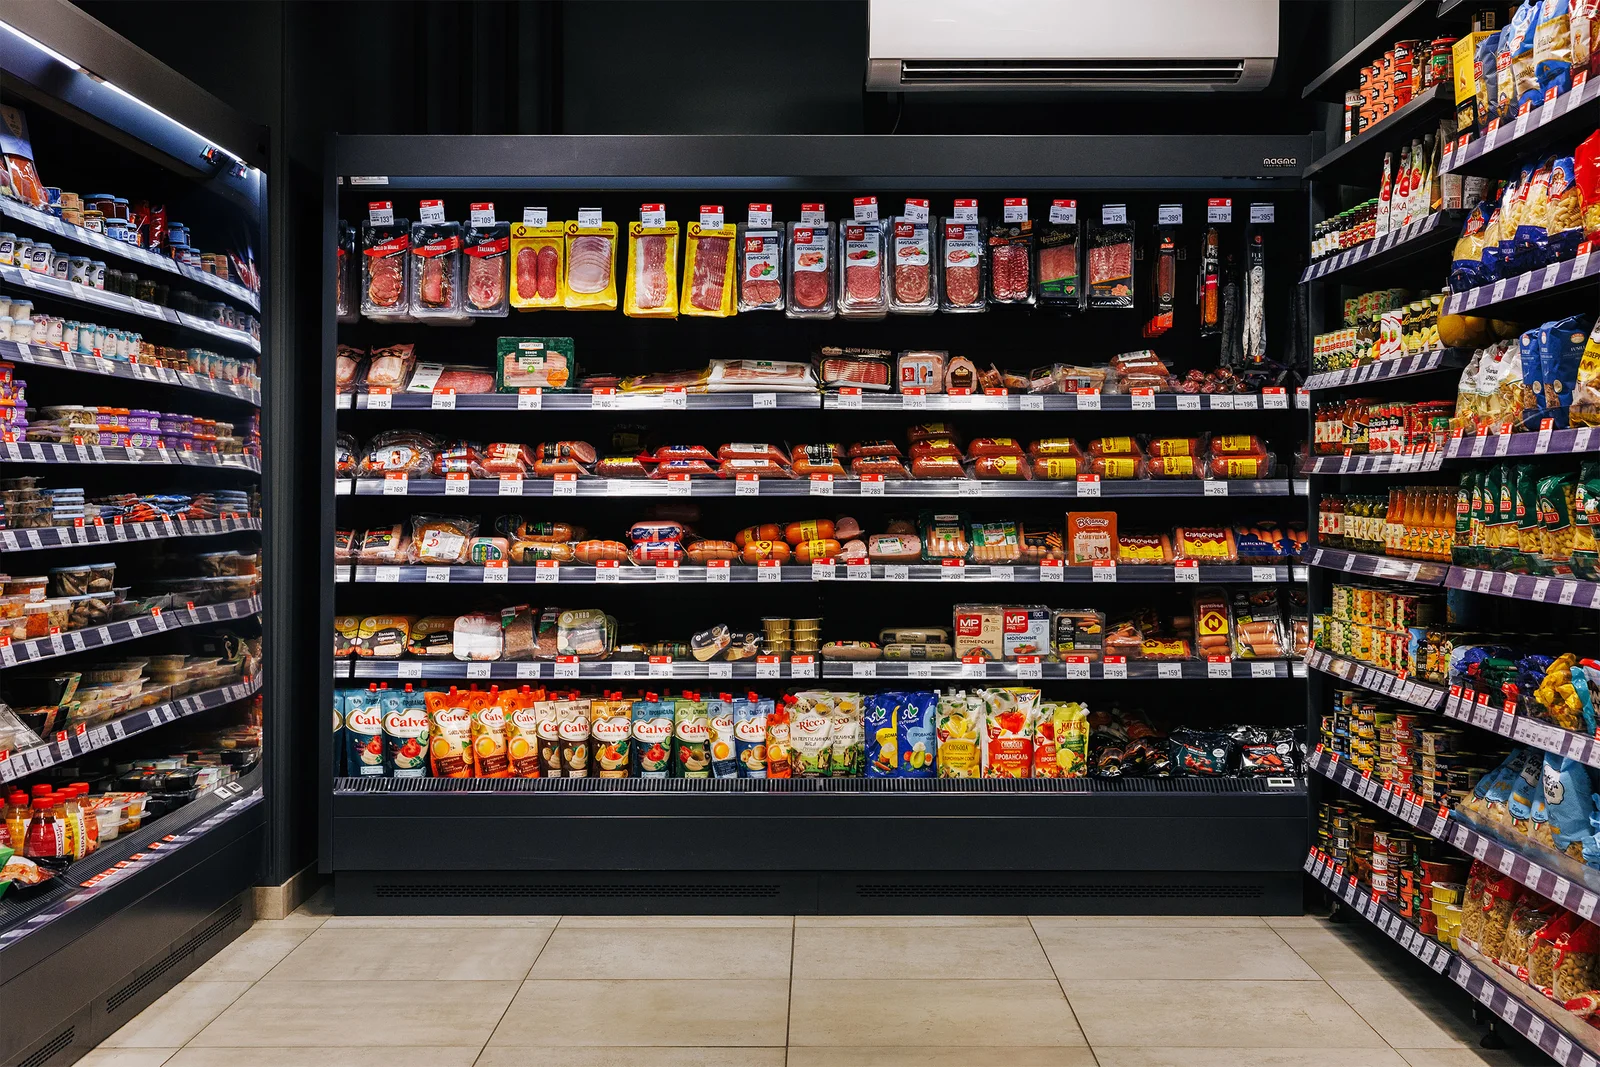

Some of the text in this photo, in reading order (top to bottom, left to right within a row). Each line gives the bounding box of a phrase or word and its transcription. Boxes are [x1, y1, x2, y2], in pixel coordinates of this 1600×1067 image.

[380, 215, 389, 223] 133
[356, 714, 381, 725] Calv
[484, 713, 503, 722] Calv
[516, 715, 536, 723] Calv
[597, 722, 630, 732] Calvé
[638, 723, 671, 733] Calvé
[741, 724, 766, 733] Calv
